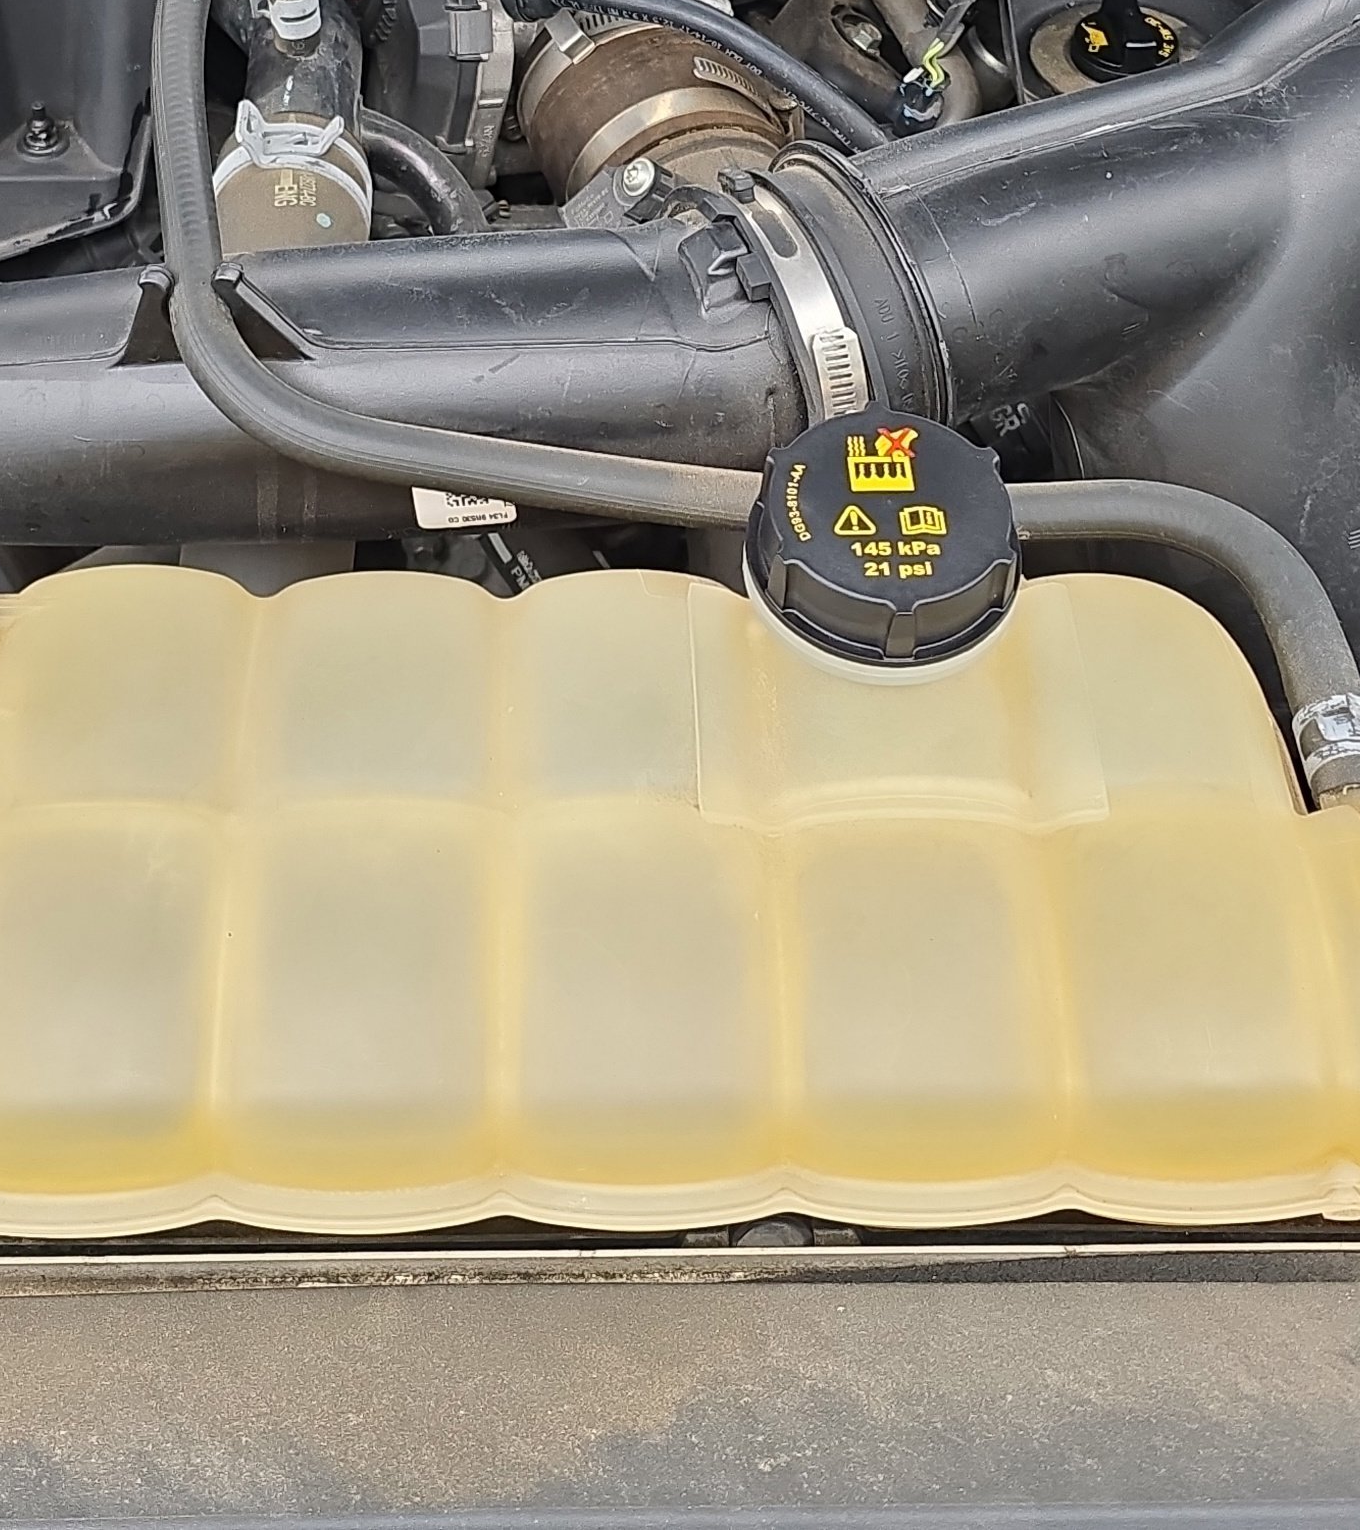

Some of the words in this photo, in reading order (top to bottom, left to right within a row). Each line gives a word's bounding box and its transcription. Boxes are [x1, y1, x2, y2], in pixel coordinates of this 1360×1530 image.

[851, 541, 892, 556] 145
[897, 541, 941, 556] kPa
[863, 561, 891, 577] 21
[899, 560, 933, 579] psi
